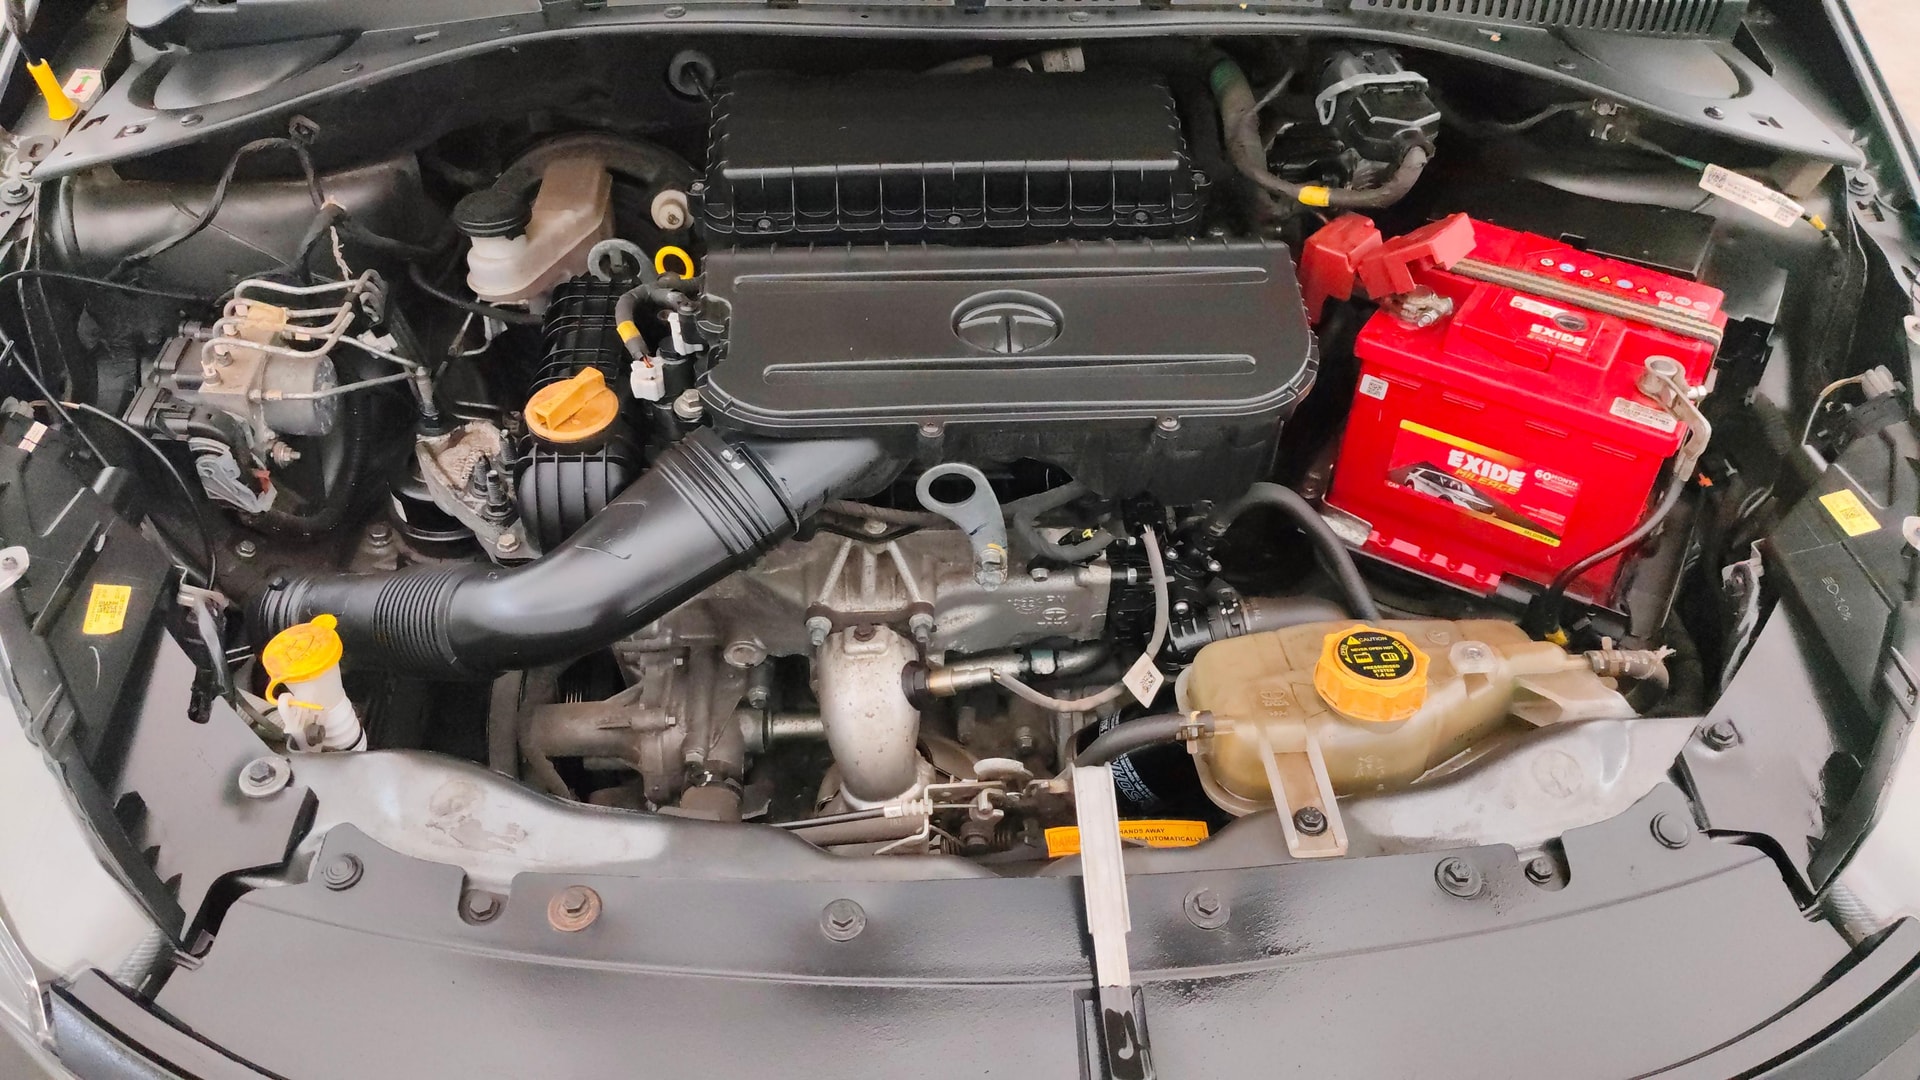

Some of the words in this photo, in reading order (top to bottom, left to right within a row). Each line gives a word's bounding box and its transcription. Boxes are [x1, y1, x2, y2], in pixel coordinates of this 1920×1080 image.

[1530, 323, 1588, 346] EXIDE
[1447, 449, 1527, 489] EXIDE
[1533, 469, 1552, 481] 60
[1551, 474, 1579, 487] MONTH
[1454, 469, 1520, 495] MILEAGE
